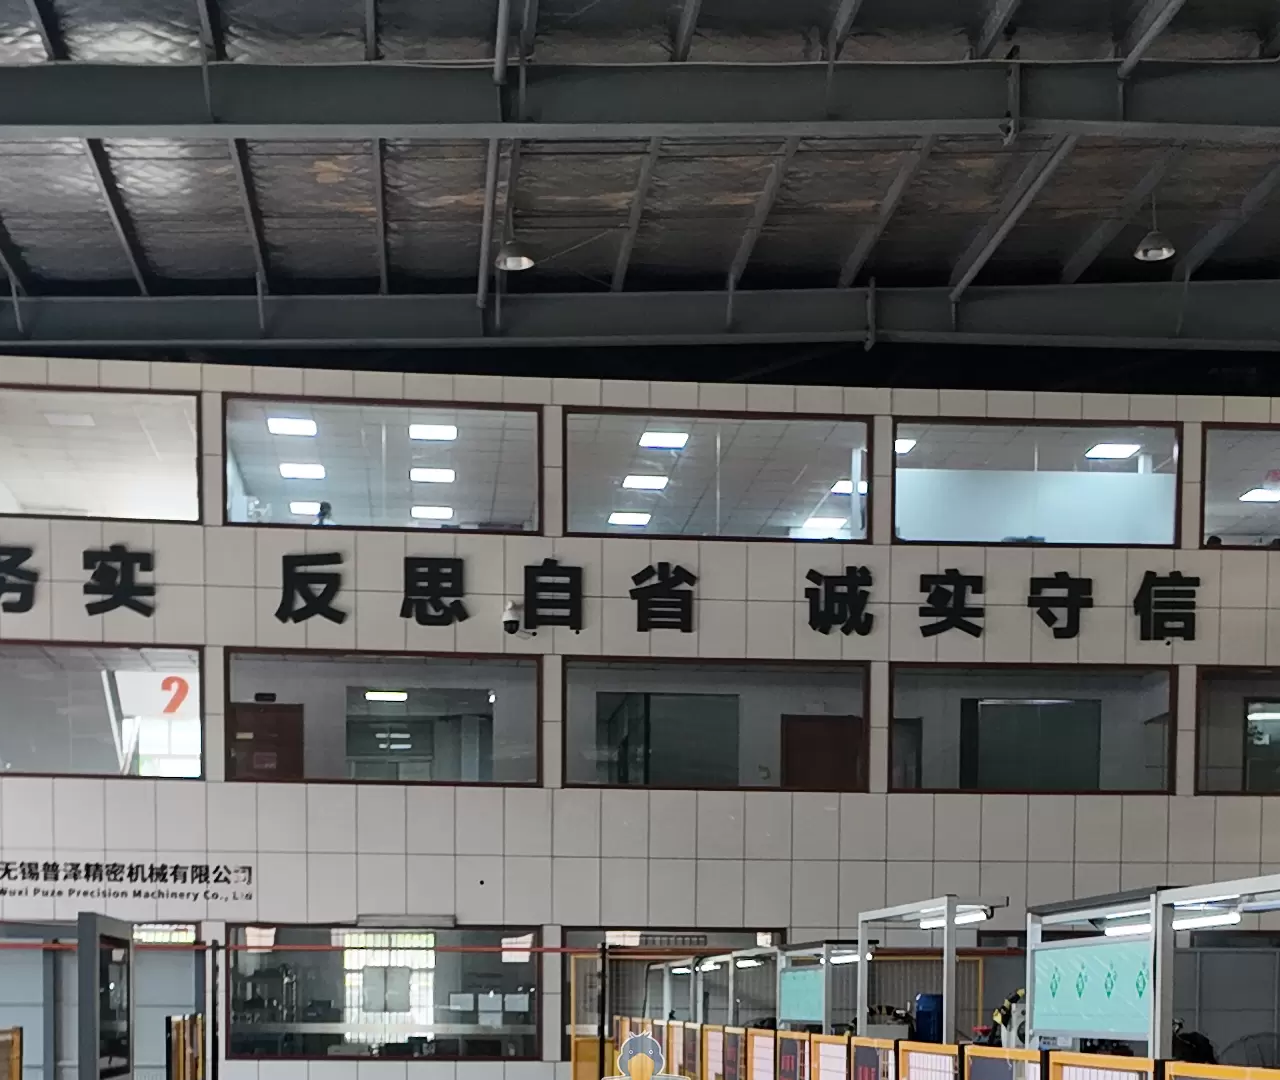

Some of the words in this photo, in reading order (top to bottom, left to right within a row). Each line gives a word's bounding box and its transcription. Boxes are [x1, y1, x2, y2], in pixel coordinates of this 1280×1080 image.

[275, 552, 698, 635] 反思自省
[804, 565, 1201, 641] 诚实守信
[33, 887, 64, 897] Puze
[68, 888, 128, 899] Precision
[133, 889, 199, 902] Machinery
